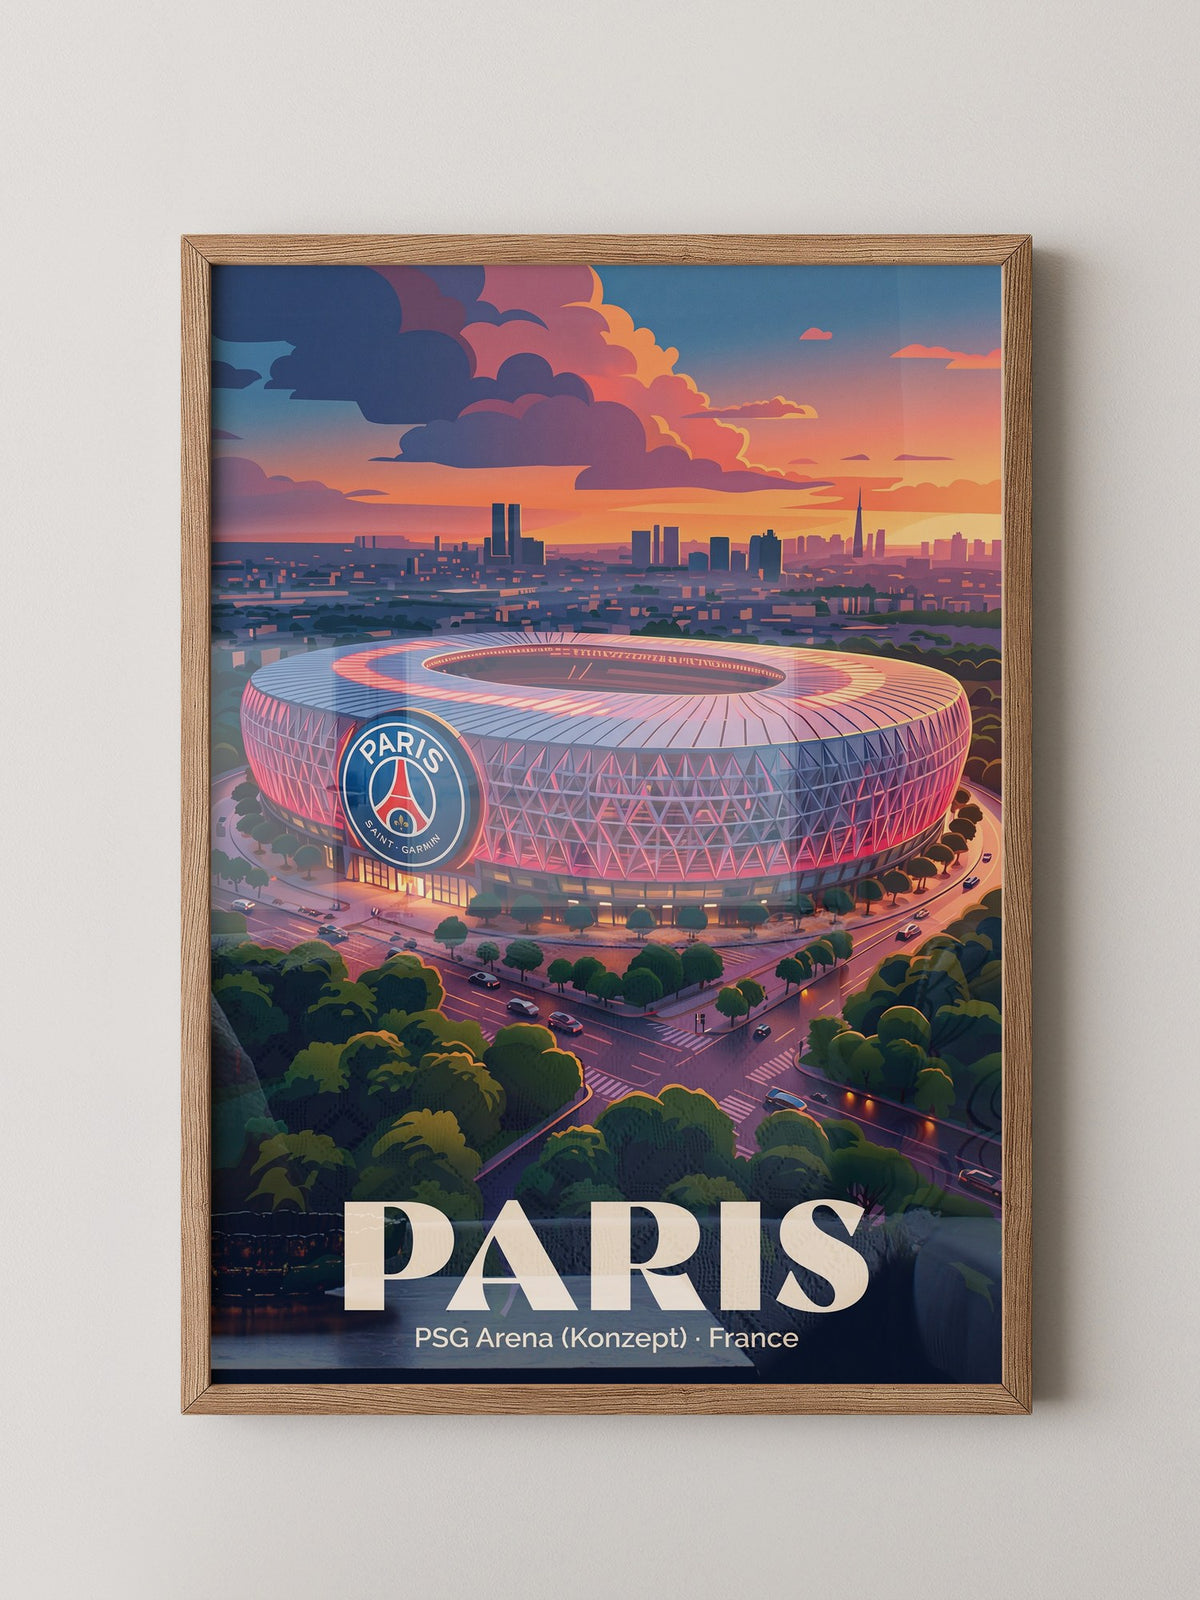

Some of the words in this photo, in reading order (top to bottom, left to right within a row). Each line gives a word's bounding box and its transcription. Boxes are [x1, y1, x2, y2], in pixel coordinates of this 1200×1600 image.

[359, 731, 444, 774] PARIS
[364, 819, 394, 849] SAINT
[343, 1198, 870, 1313] PARIS
[415, 1327, 469, 1348] PSG
[476, 1327, 554, 1348] Arena
[561, 1326, 687, 1353] (Konzept)
[709, 1327, 799, 1348] France
